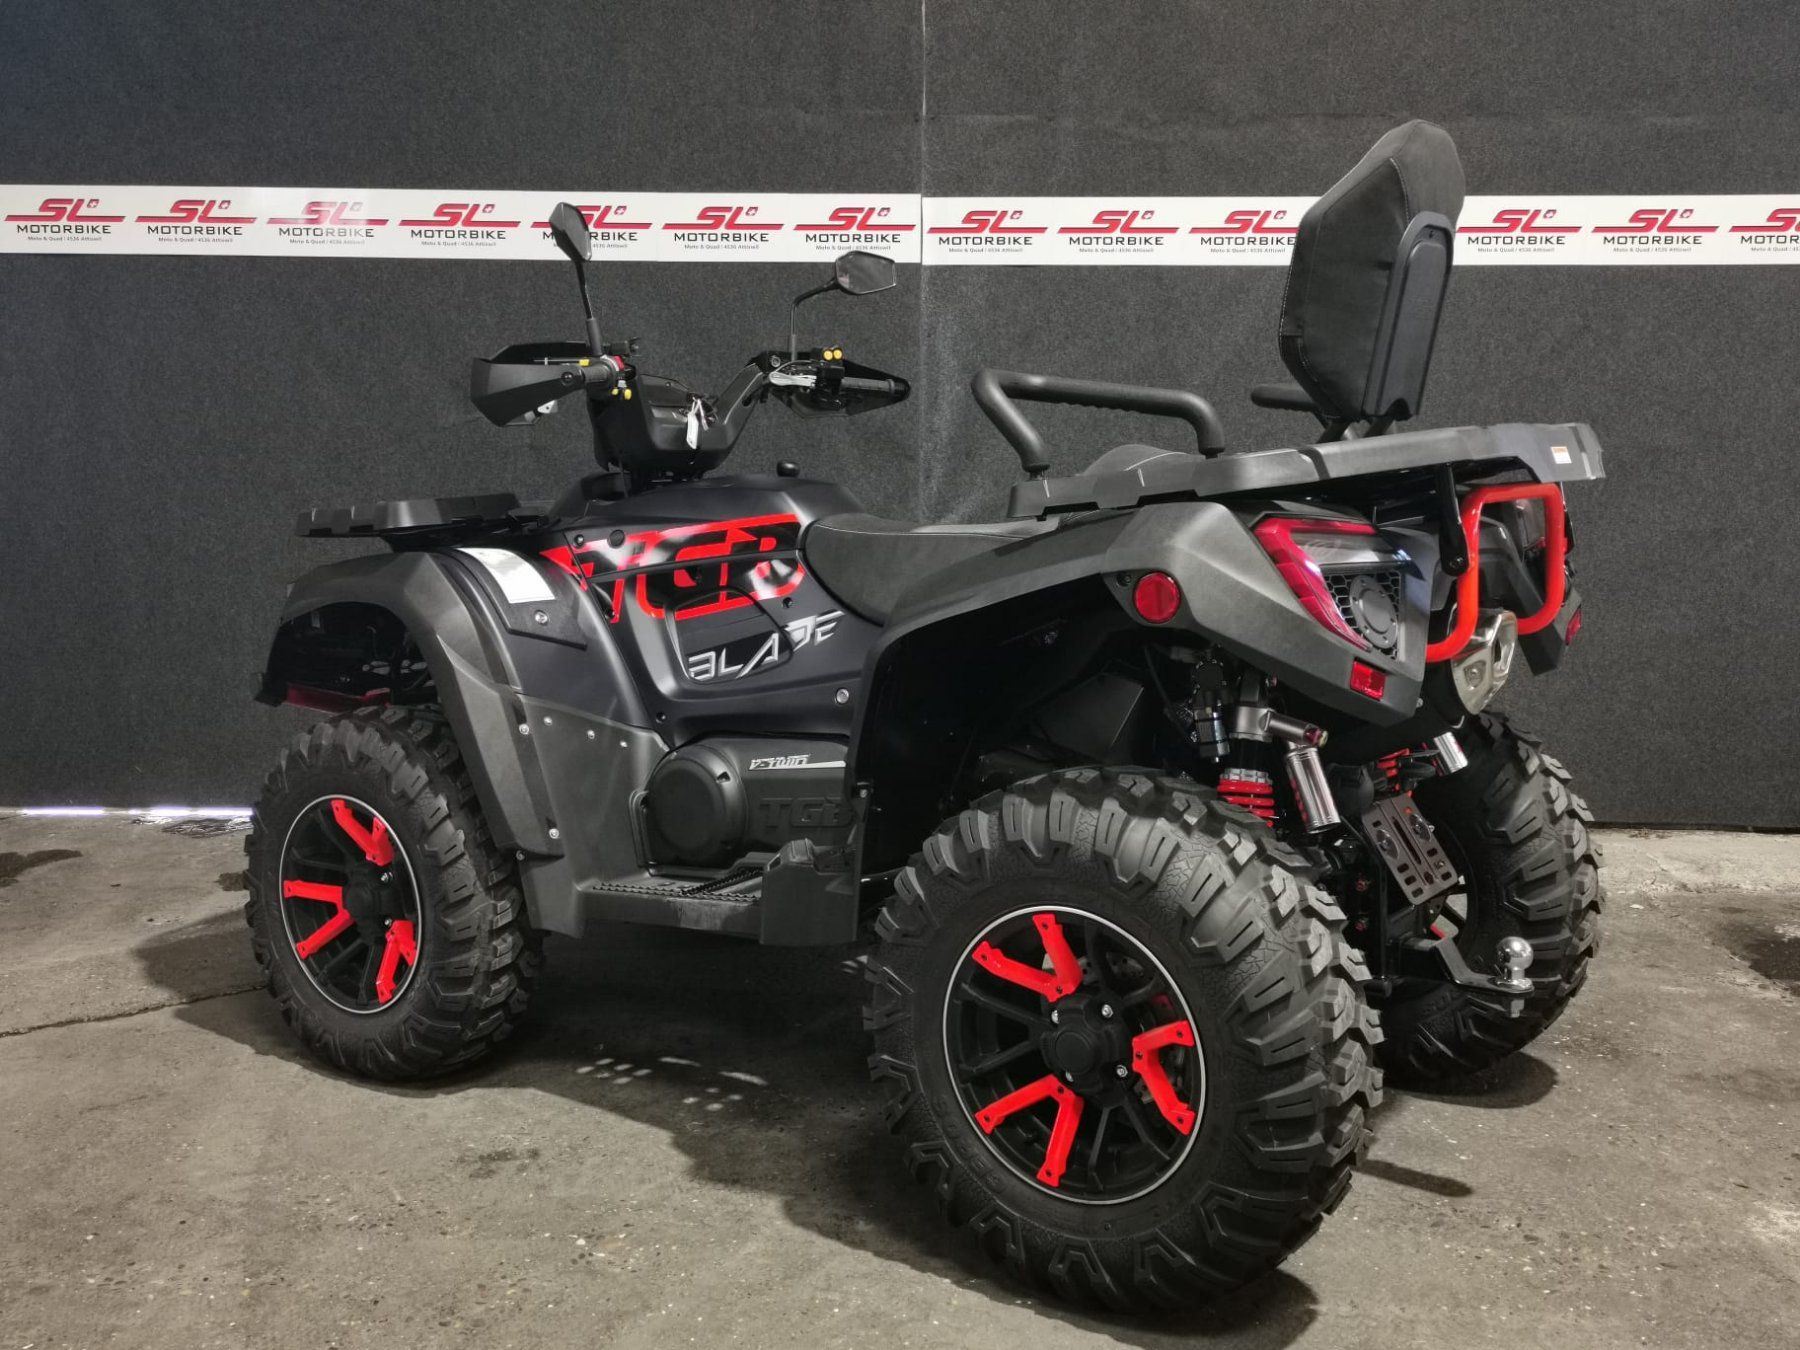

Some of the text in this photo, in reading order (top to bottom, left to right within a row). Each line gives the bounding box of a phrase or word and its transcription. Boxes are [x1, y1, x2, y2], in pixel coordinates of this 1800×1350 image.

[17, 225, 111, 234] MOTORBIKE
[148, 226, 242, 235] MOTORBIKE
[279, 228, 374, 237] MOTORBIKE
[411, 230, 505, 239] MOTORBIKE
[543, 232, 638, 241] MRBIKE
[674, 233, 768, 242] MOTORBIKE
[805, 234, 900, 242] MOTORBIKE
[938, 237, 1032, 246] MOTORBIKE
[1069, 237, 1163, 246] MOTORBIKE
[1201, 237, 1296, 246] MOTORBIKE
[1468, 236, 1565, 245] MOTORBIKE
[1604, 236, 1702, 245] MOTORBIKE
[688, 610, 845, 681] BLADE
